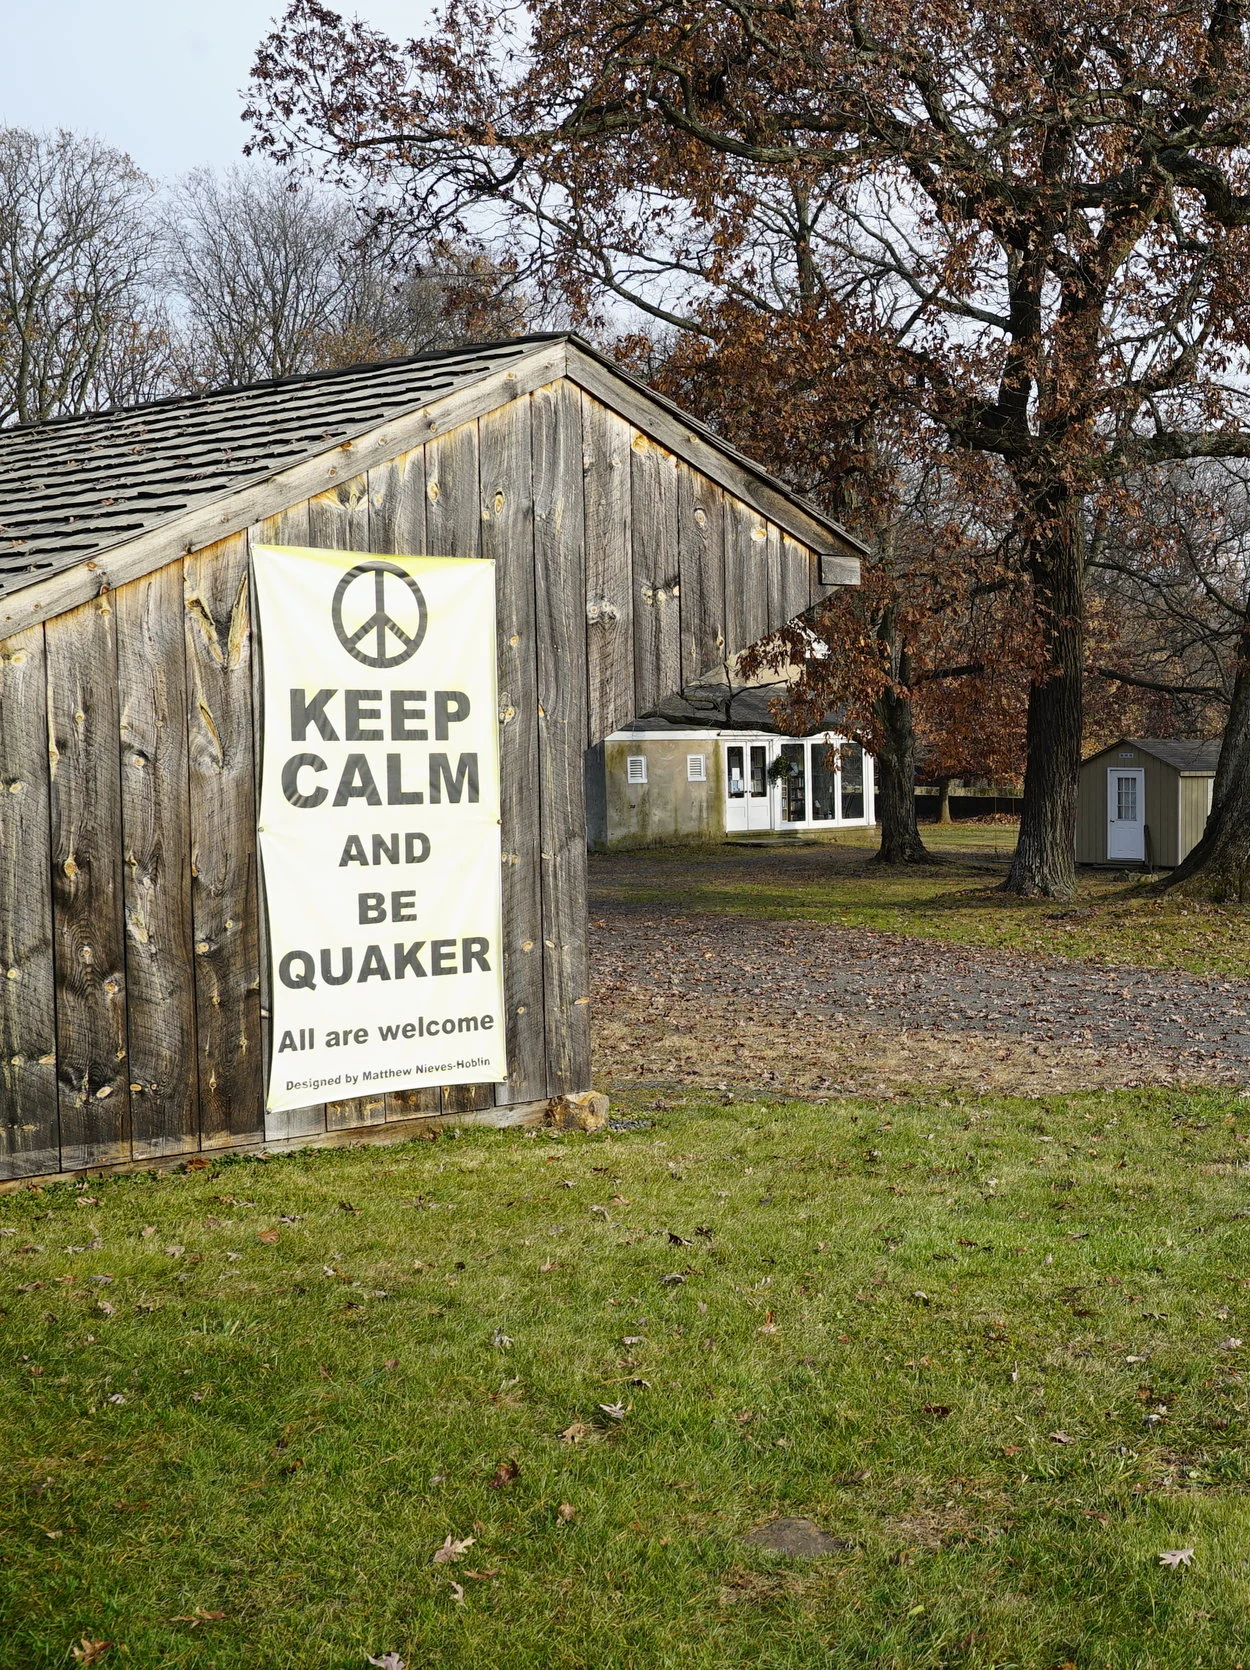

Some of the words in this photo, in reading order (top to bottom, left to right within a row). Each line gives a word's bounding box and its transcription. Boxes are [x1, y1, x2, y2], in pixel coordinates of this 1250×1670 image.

[290, 688, 471, 742] KEEP
[281, 752, 480, 808] CALM
[338, 832, 431, 867] AND
[358, 890, 417, 925] BE
[278, 936, 492, 991] QUAKER
[278, 1028, 315, 1053] All
[325, 1027, 369, 1049] are
[378, 1014, 495, 1041] welcome
[286, 1074, 341, 1091] Designed
[345, 1072, 359, 1085] by
[362, 1067, 412, 1081] Matthew
[415, 1057, 491, 1074] Nieves-Hoblin
